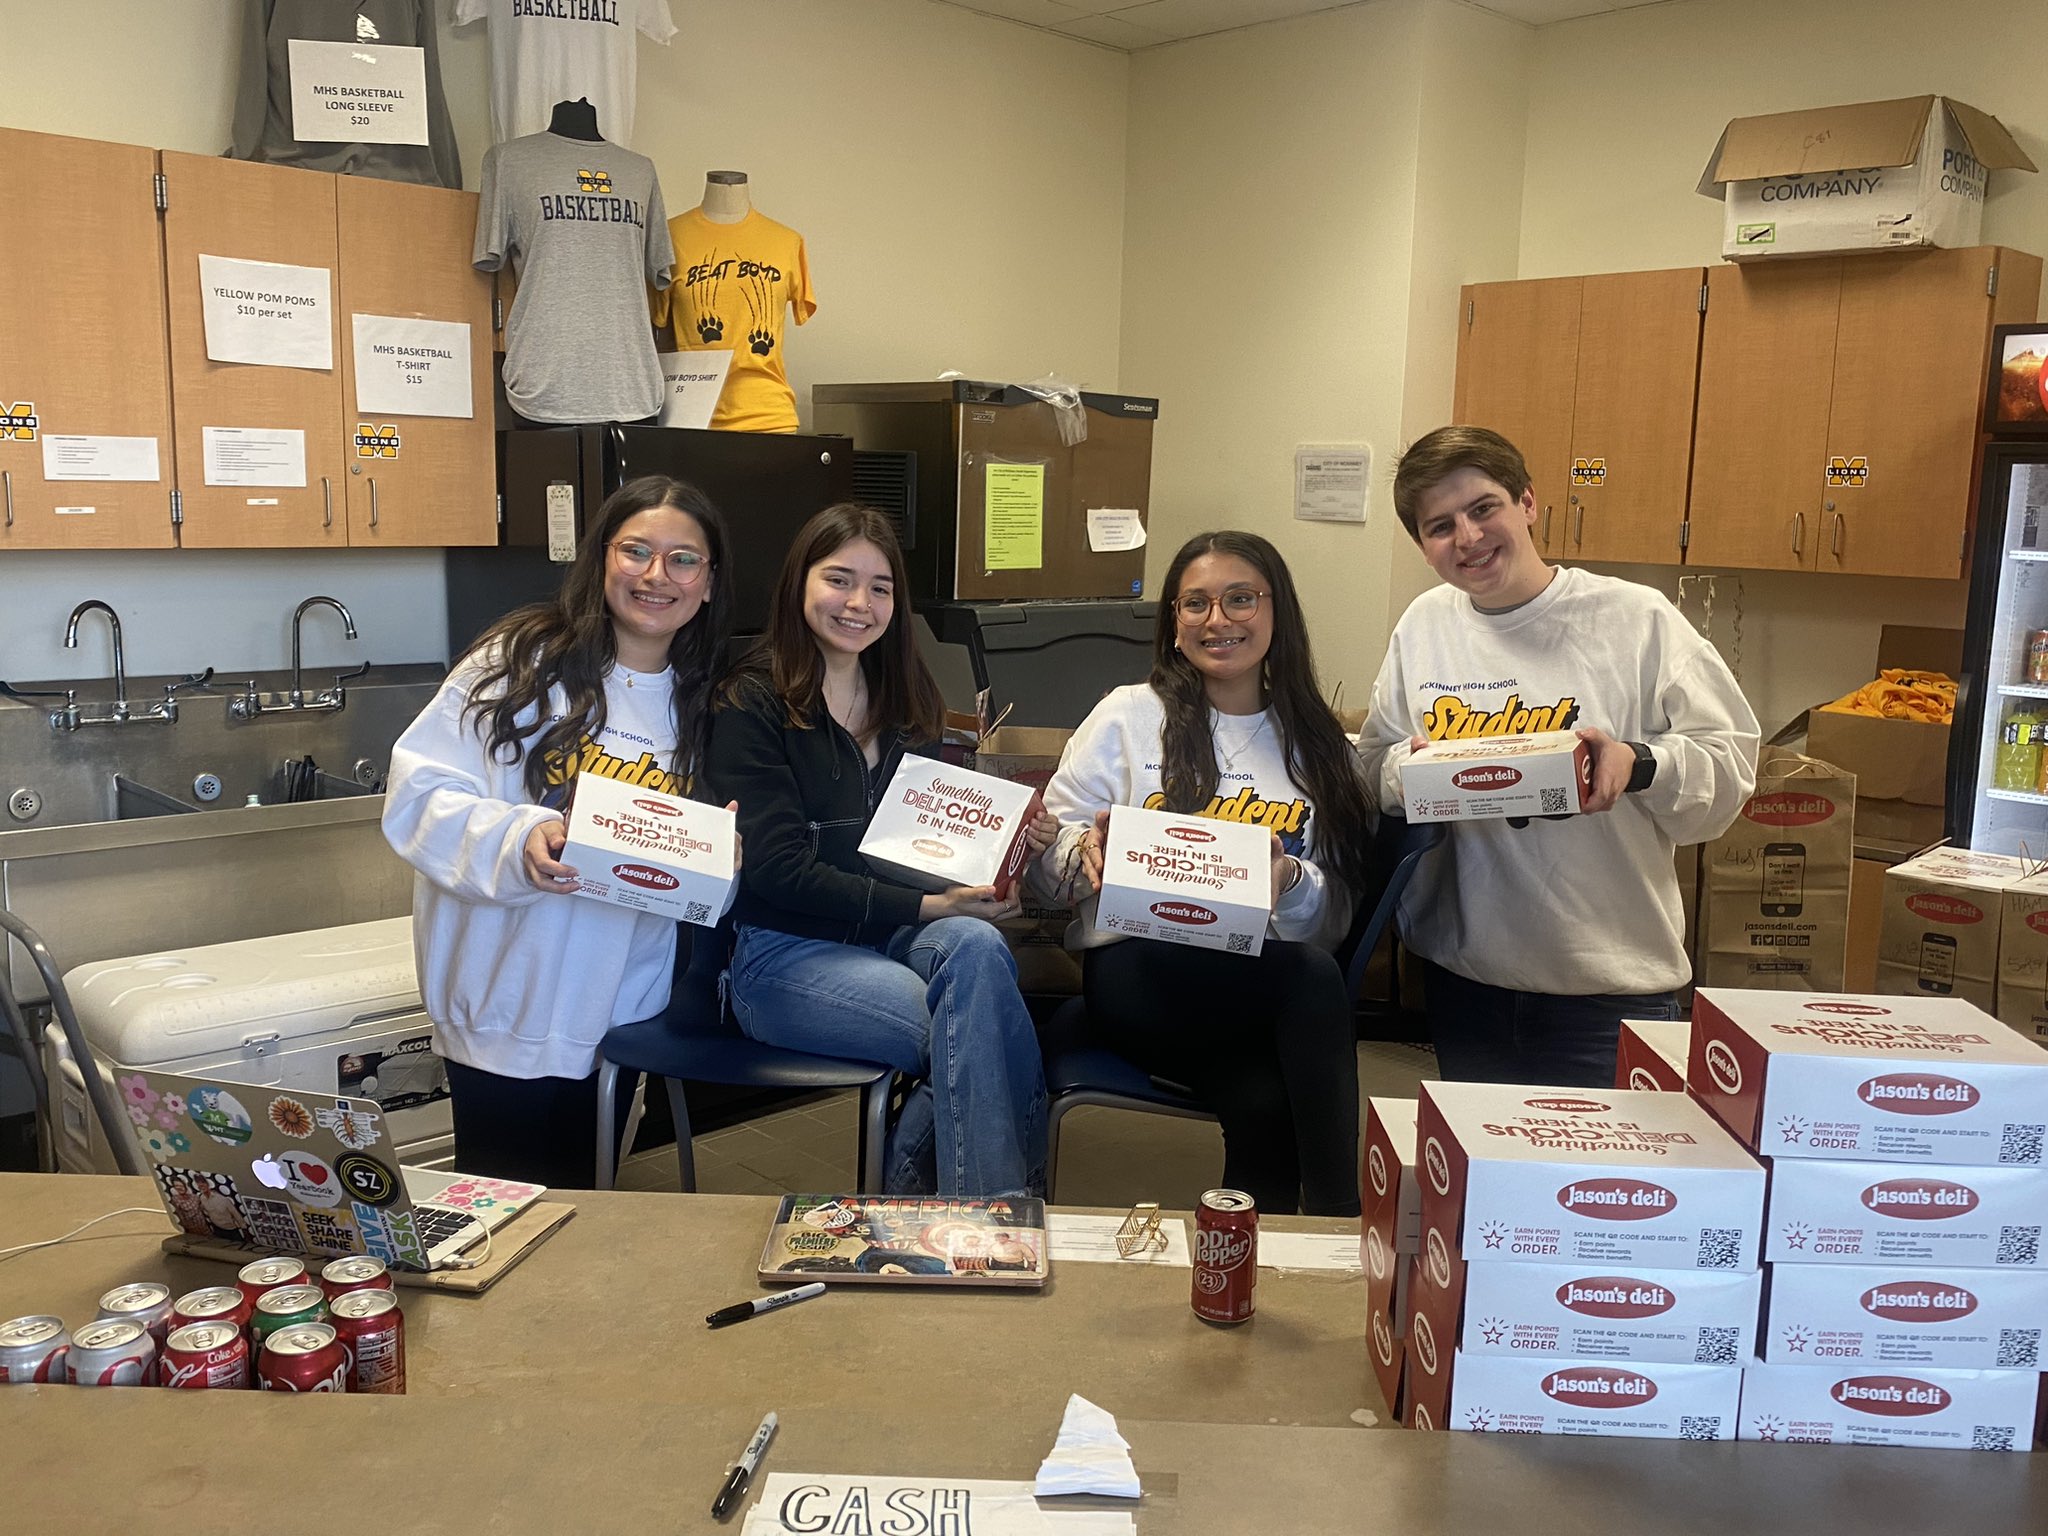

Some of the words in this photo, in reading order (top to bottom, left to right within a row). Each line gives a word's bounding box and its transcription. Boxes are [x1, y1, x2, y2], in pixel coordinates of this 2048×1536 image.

[513, 0, 619, 26] BASKETBALL
[313, 85, 338, 95] MHS
[340, 87, 404, 99] BASKETBALL
[325, 101, 355, 111] LONG
[357, 102, 394, 112] SLEEVE
[351, 115, 370, 125] $20
[1761, 176, 1881, 202] COMPANY
[686, 260, 736, 287] BEAT
[737, 261, 781, 282] BOYD
[214, 287, 255, 300] YELLOW
[257, 293, 282, 303] POM
[285, 296, 316, 306] POMS
[237, 305, 255, 315] $10
[258, 309, 275, 317] per
[277, 311, 292, 319] set
[373, 345, 395, 354] MHS
[397, 347, 453, 359] BASKETBALL
[396, 361, 431, 371] T-SHIRT
[406, 374, 422, 384] $15
[675, 385, 684, 393] $5
[0, 417, 35, 426] ONS
[356, 437, 398, 446] LIONS
[1419, 682, 1461, 692] MCKINNEY
[1463, 682, 1485, 690] HIGH
[1488, 678, 1518, 690] SCHOOL
[1423, 694, 1577, 741] Student
[620, 731, 655, 746] SCHOOL
[1457, 772, 1493, 786] Jason's
[1494, 770, 1516, 781] deli
[927, 778, 993, 813] Something
[903, 789, 1004, 831] DELI-CIOUS
[1748, 800, 1796, 817] Jason's
[1799, 800, 1826, 813] deli
[658, 821, 672, 831] IN
[677, 827, 689, 836] IS
[916, 813, 928, 825] IS
[930, 817, 944, 830] IN
[945, 821, 977, 839] HERE.
[611, 828, 692, 858] Something
[1193, 851, 1206, 860] IN
[1211, 854, 1223, 863] IS
[616, 866, 653, 882] Jason's
[653, 874, 675, 887] deli
[1146, 865, 1228, 890] Something
[1154, 904, 1191, 917] Jason's
[1191, 909, 1212, 920] deli
[1911, 897, 1951, 913] Jason's
[1953, 904, 1978, 918] deli
[2011, 895, 2042, 912] HAM
[1744, 922, 1817, 931] jasonsdeli.com
[381, 1039, 431, 1058] MAXCOL
[1865, 1080, 1930, 1102] Jason's
[1932, 1083, 1970, 1102] deli
[1586, 1121, 1611, 1129] IN
[1618, 1122, 1640, 1130] IS
[1812, 1129, 1833, 1137] WITH
[1835, 1130, 1859, 1138] EVERY
[1528, 1135, 1668, 1155] Something
[1809, 1137, 1861, 1150] ORDER.
[283, 1159, 300, 1181] I
[353, 1170, 380, 1190] SZ
[289, 1182, 336, 1196] Yearbook
[1565, 1185, 1629, 1207] Jason's
[1631, 1189, 1668, 1207] deli
[1869, 1186, 1931, 1207] Jason's
[1934, 1188, 1969, 1206] deli
[302, 1212, 336, 1226] SEEK
[307, 1224, 354, 1241] SHARE
[352, 1203, 393, 1265] GIVE
[386, 1211, 426, 1269] ASK
[1209, 1230, 1234, 1249] Dr
[1620, 1233, 1640, 1241] CODE
[311, 1236, 352, 1252] SHINE
[1196, 1230, 1248, 1267] Pepper
[1510, 1243, 1561, 1255] ORDER.
[1201, 1273, 1214, 1288] 23
[1564, 1284, 1627, 1306] Jason's
[1629, 1287, 1665, 1305] deli
[1868, 1289, 1930, 1310] Jason's
[1932, 1292, 1968, 1309] deli
[1510, 1339, 1560, 1351] ORDER.
[1549, 1374, 1610, 1396] Jason's
[1613, 1378, 1648, 1395] deli
[1838, 1381, 1903, 1403] Jason's
[1905, 1387, 1941, 1405] deli
[780, 1485, 971, 1536] CASH
